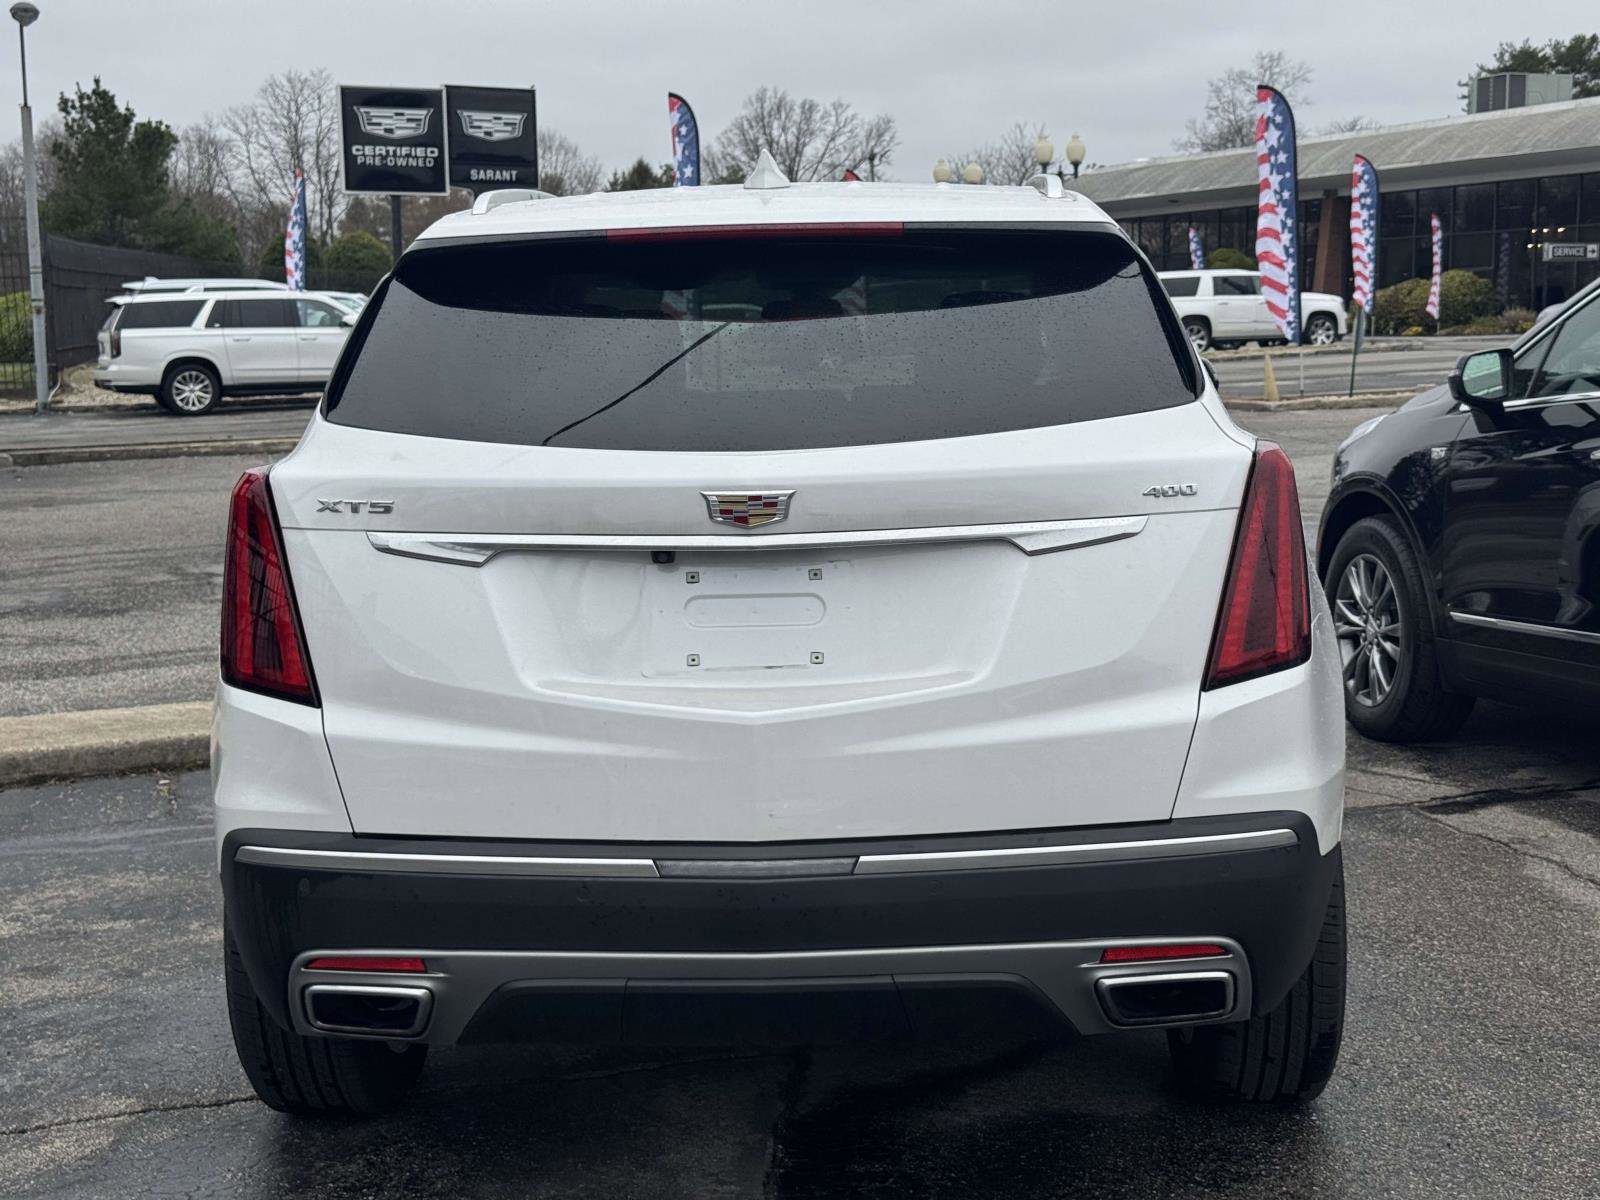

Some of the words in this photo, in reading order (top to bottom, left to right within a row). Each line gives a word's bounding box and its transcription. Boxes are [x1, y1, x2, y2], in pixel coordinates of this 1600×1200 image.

[351, 145, 439, 157] CERTIFIED
[357, 156, 435, 167] PRE-OWNED
[470, 168, 518, 181] SARANT
[1553, 246, 1585, 257] SERVICE
[1142, 484, 1198, 498] 400
[315, 497, 395, 514] XT5
